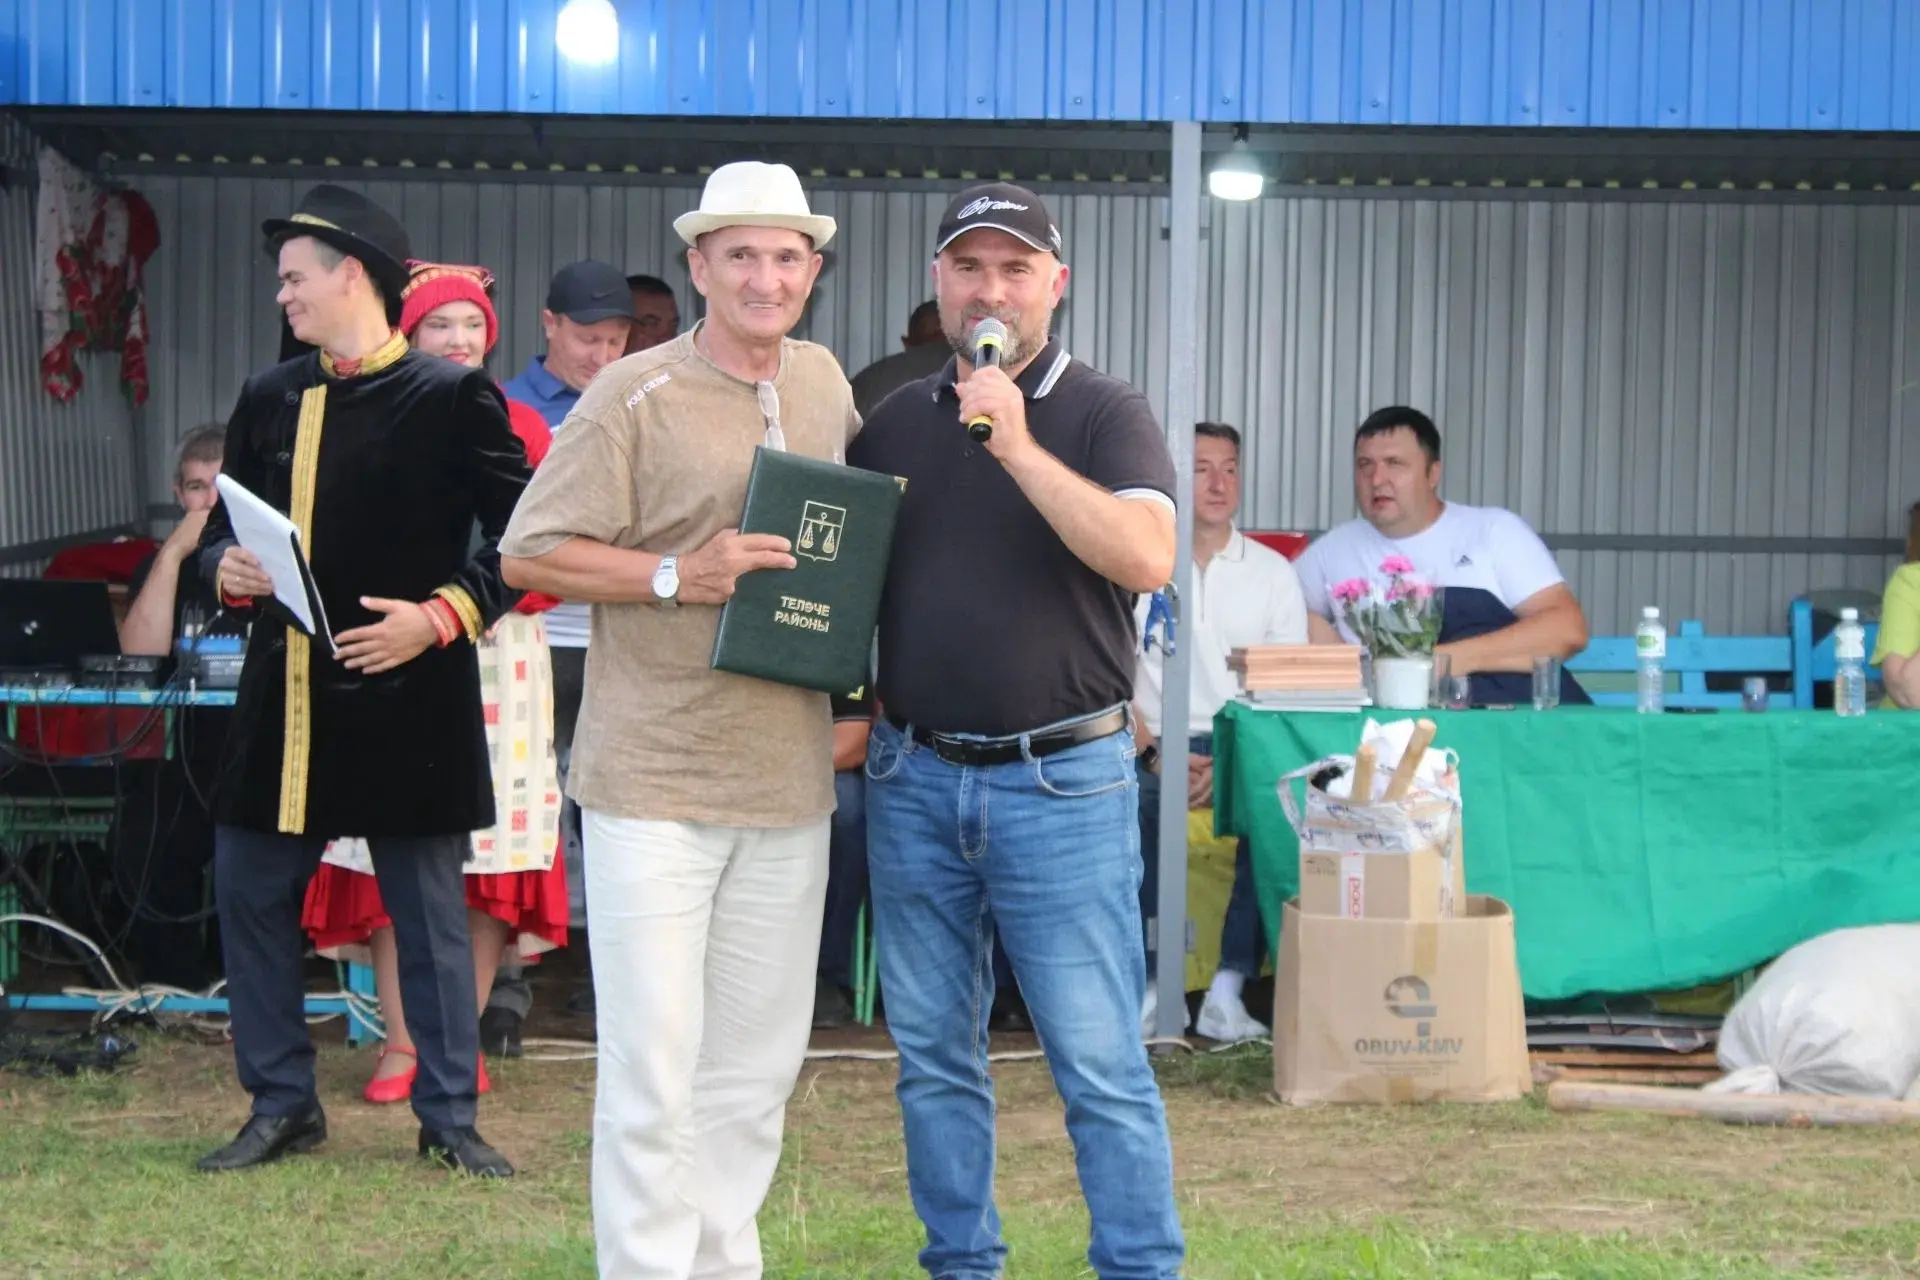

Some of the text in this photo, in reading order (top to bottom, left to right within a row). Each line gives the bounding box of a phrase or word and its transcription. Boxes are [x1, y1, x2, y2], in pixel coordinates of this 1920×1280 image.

[780, 595, 831, 617] ТЕЛӘЧЕ
[774, 610, 830, 633] РАЙОНЫ
[1354, 1038, 1464, 1055] OBUV-KMV
